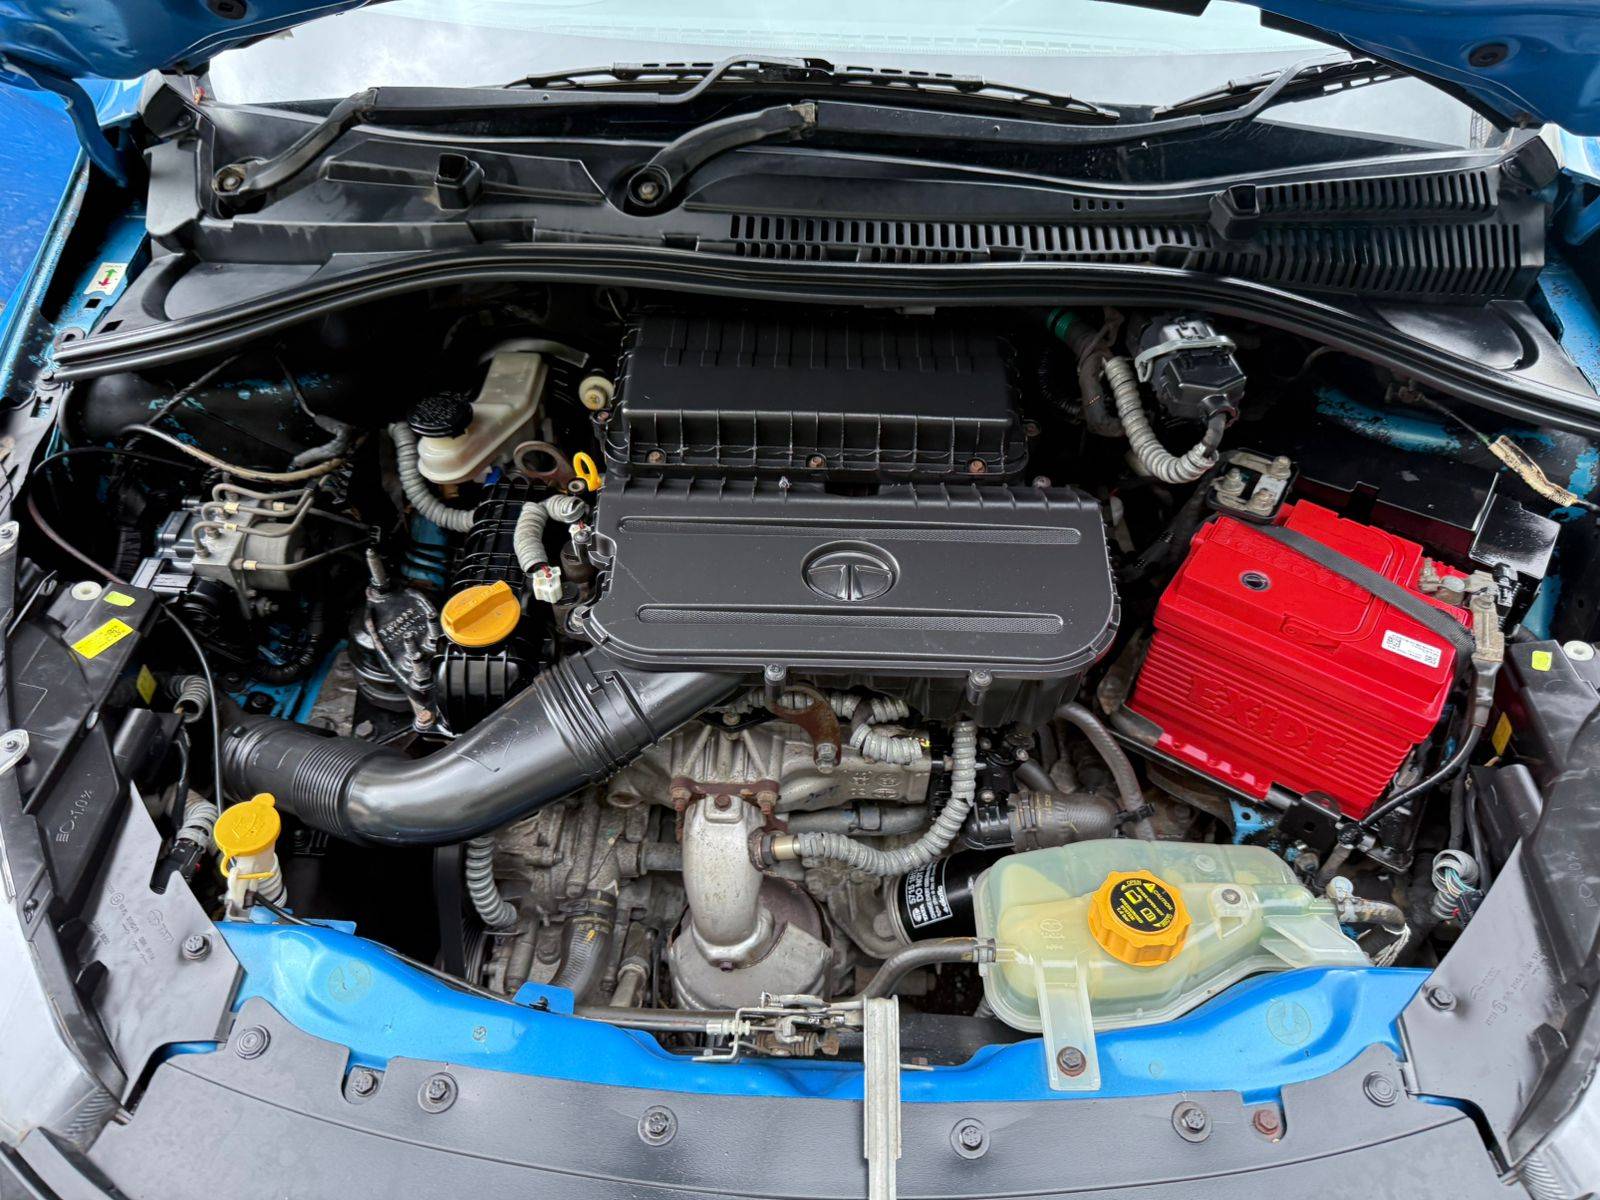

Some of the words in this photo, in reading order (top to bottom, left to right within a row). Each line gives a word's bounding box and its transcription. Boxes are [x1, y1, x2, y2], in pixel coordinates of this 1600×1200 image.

[1188, 675, 1345, 765] EXIDE
[915, 872, 923, 887] NOT
[915, 888, 924, 902] DO
[1154, 890, 1173, 910] CAUTION
